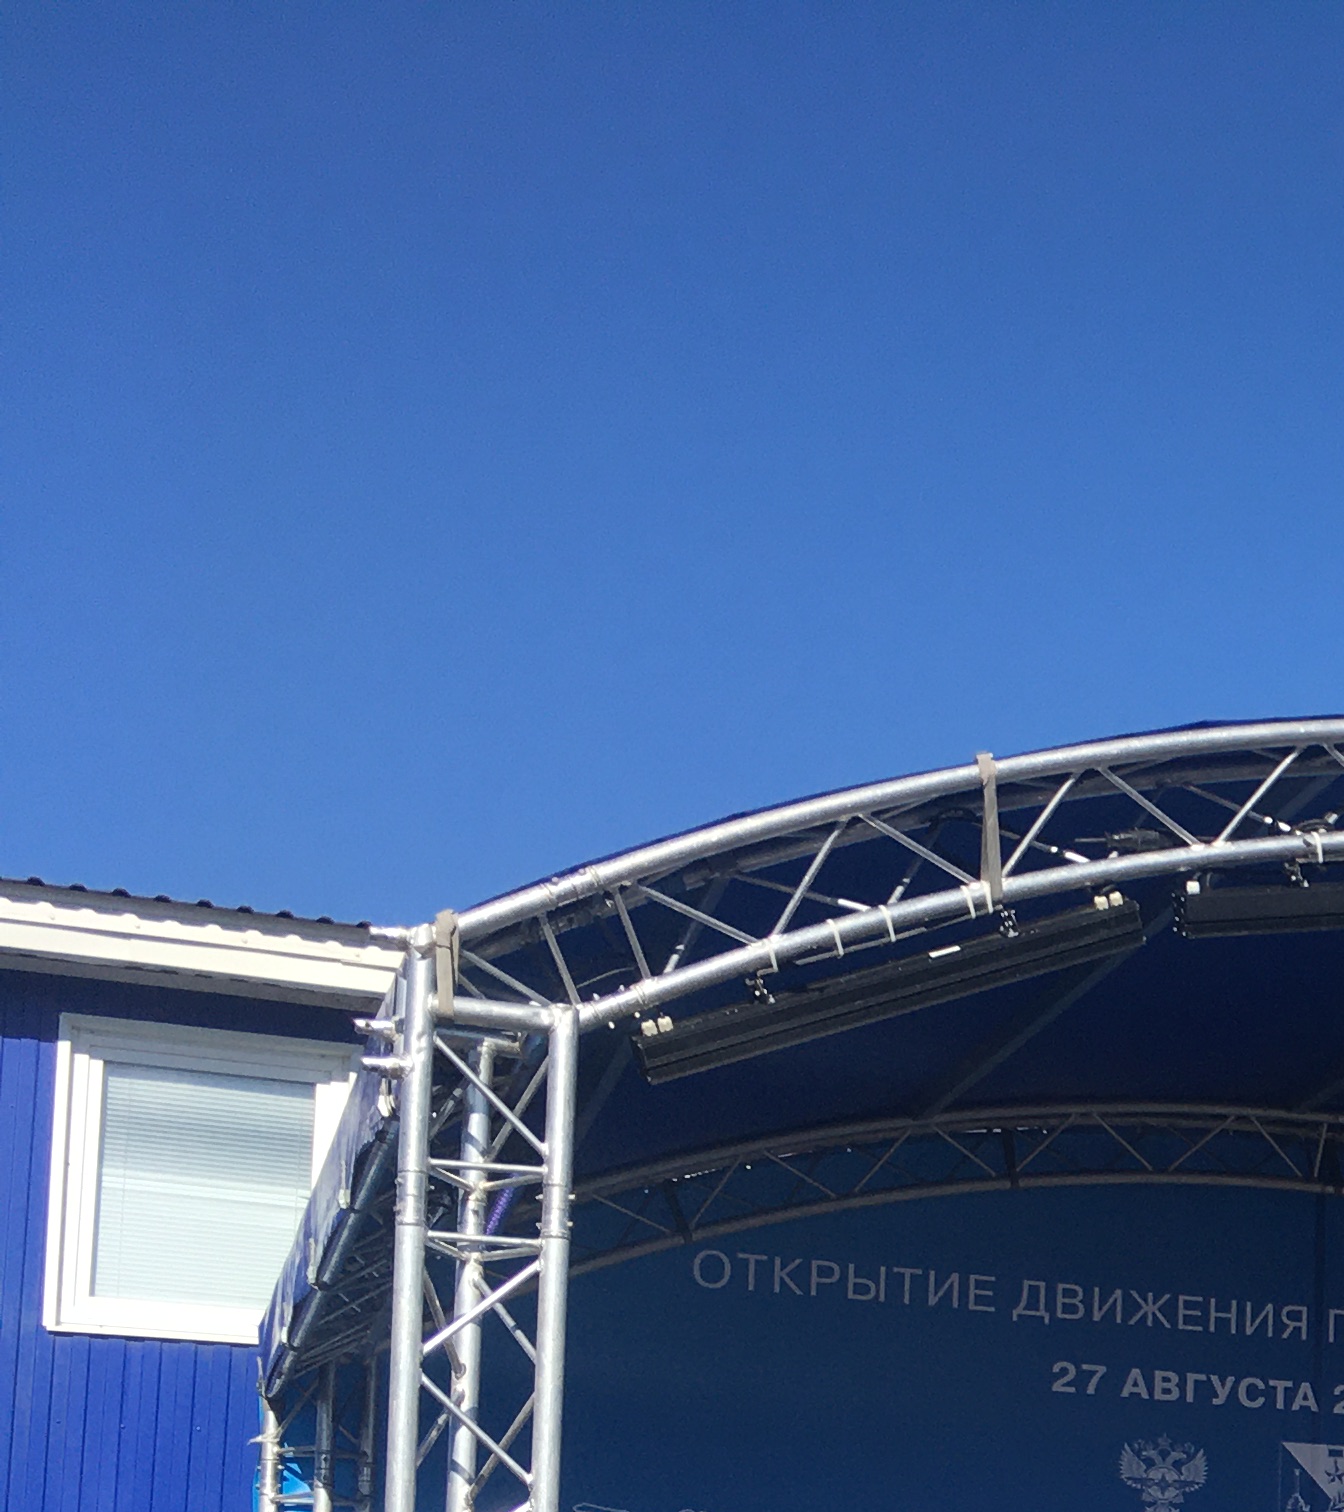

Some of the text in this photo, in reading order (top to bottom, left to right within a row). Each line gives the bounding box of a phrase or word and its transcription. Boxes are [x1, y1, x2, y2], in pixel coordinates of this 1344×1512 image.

[693, 1249, 996, 1312] ОТКРЫТИЕ
[1012, 1279, 1309, 1341] ДВИЖЕНИЯ
[1051, 1361, 1107, 1395] 27
[1120, 1368, 1320, 1413] АВГУСТА
